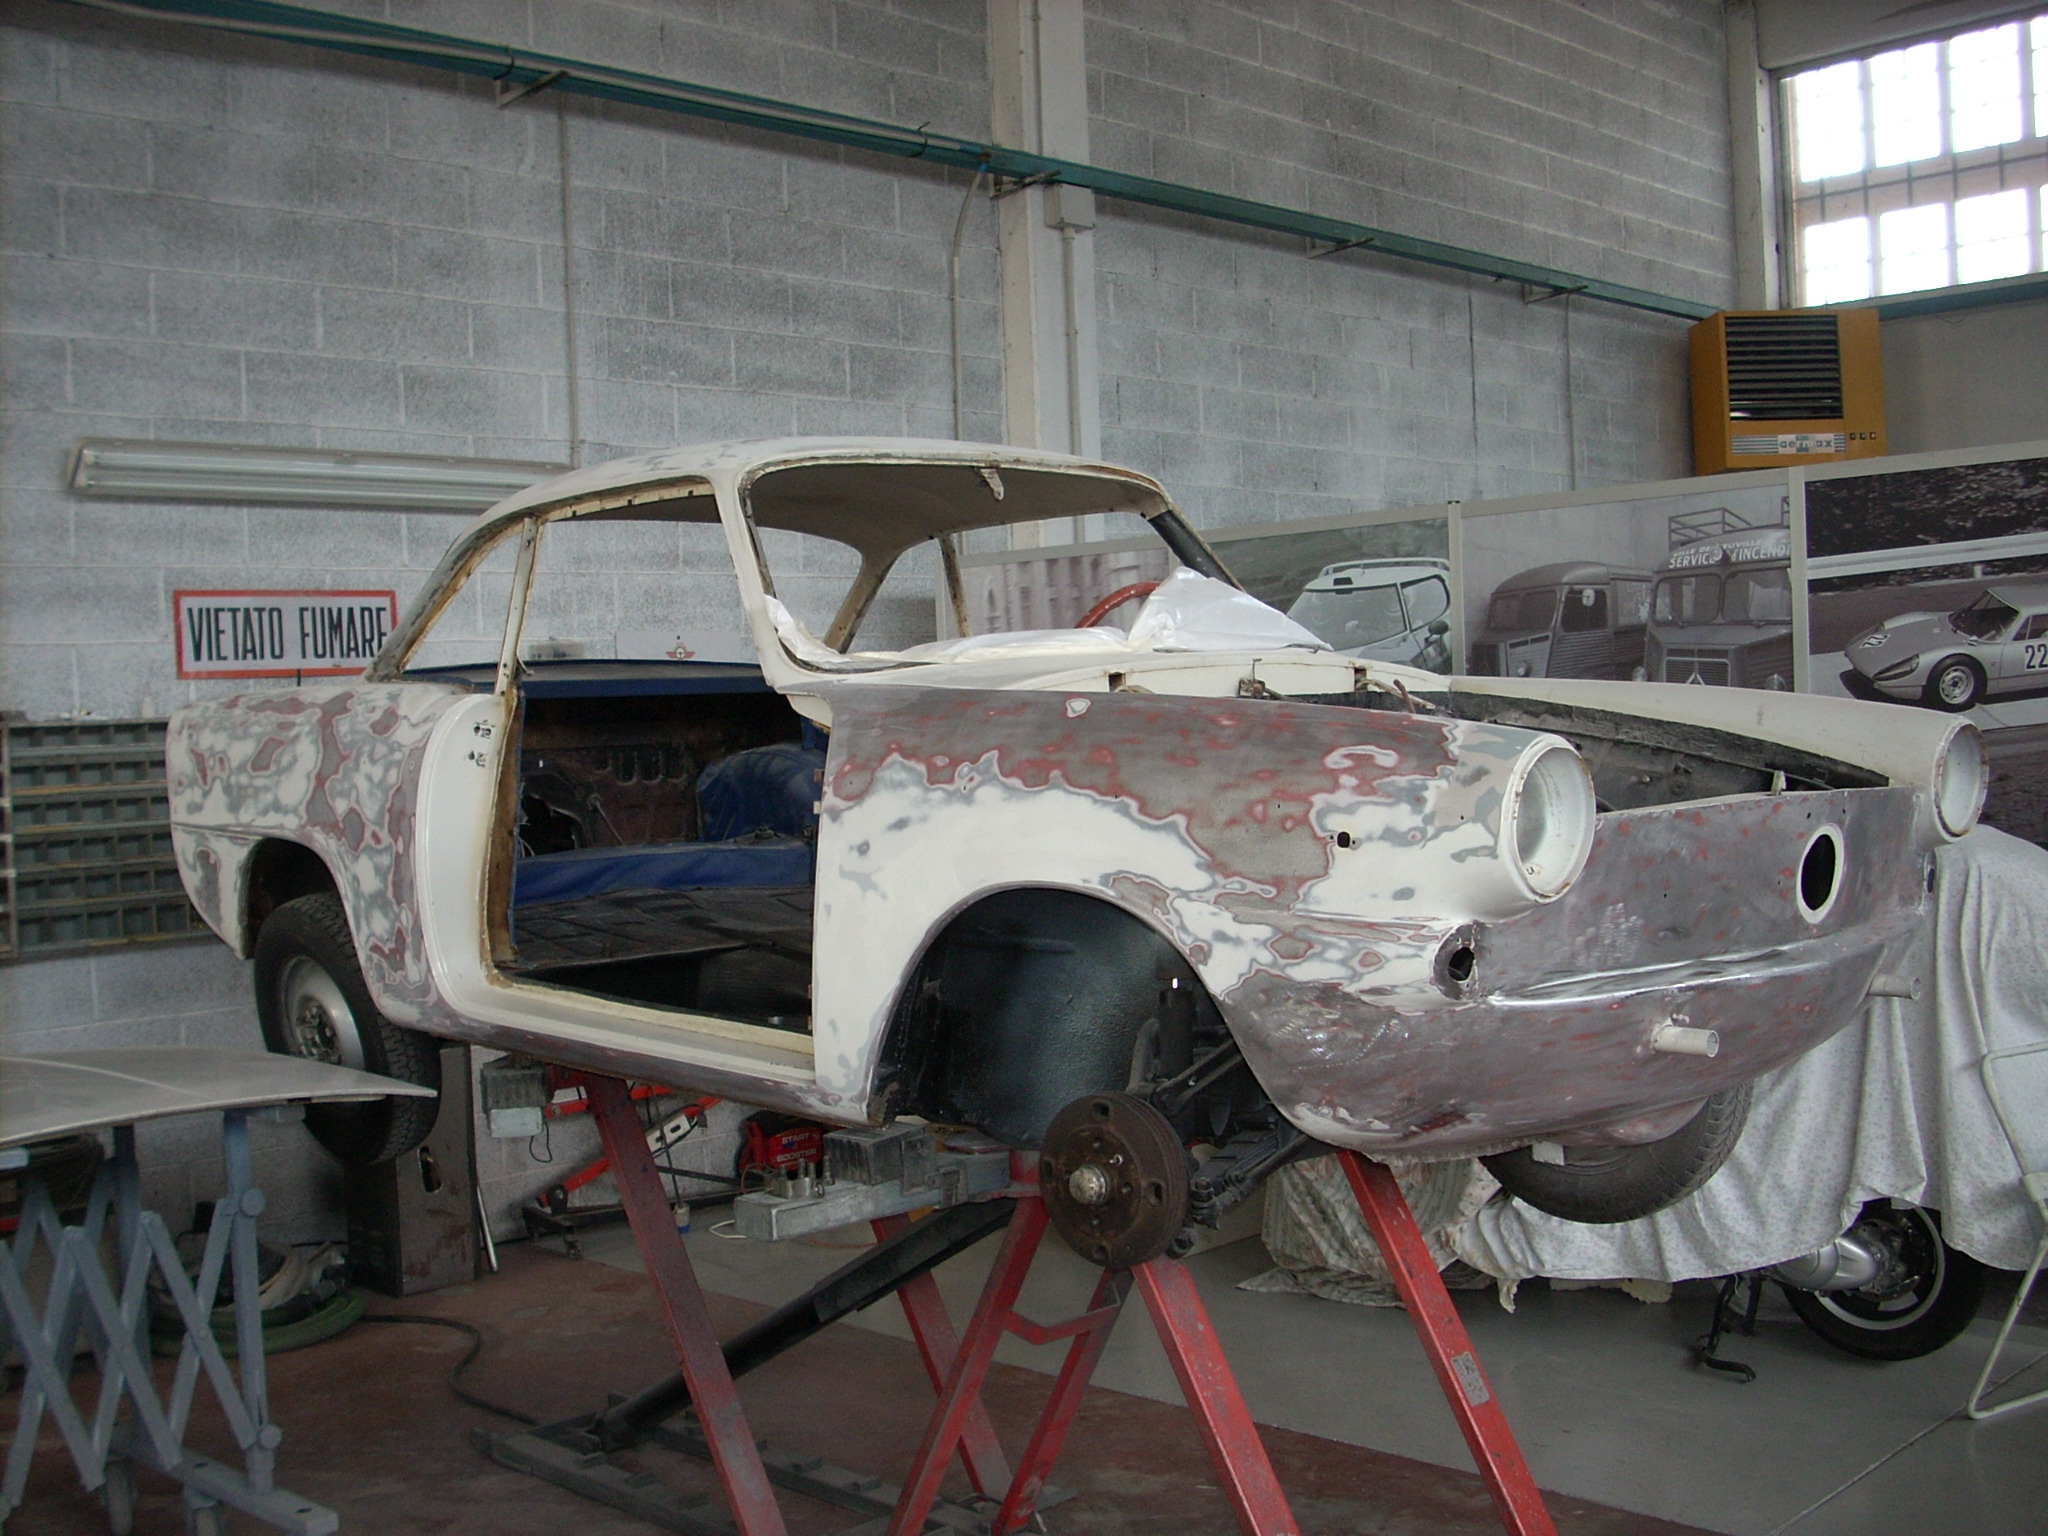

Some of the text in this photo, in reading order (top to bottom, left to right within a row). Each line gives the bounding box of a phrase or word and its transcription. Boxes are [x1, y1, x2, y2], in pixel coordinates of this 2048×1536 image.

[187, 607, 388, 662] VIETATO FUMARE
[1862, 634, 1887, 647] 22
[2025, 644, 2048, 669] 22
[782, 1132, 810, 1145] START
[777, 1147, 817, 1162] BOOSTER
